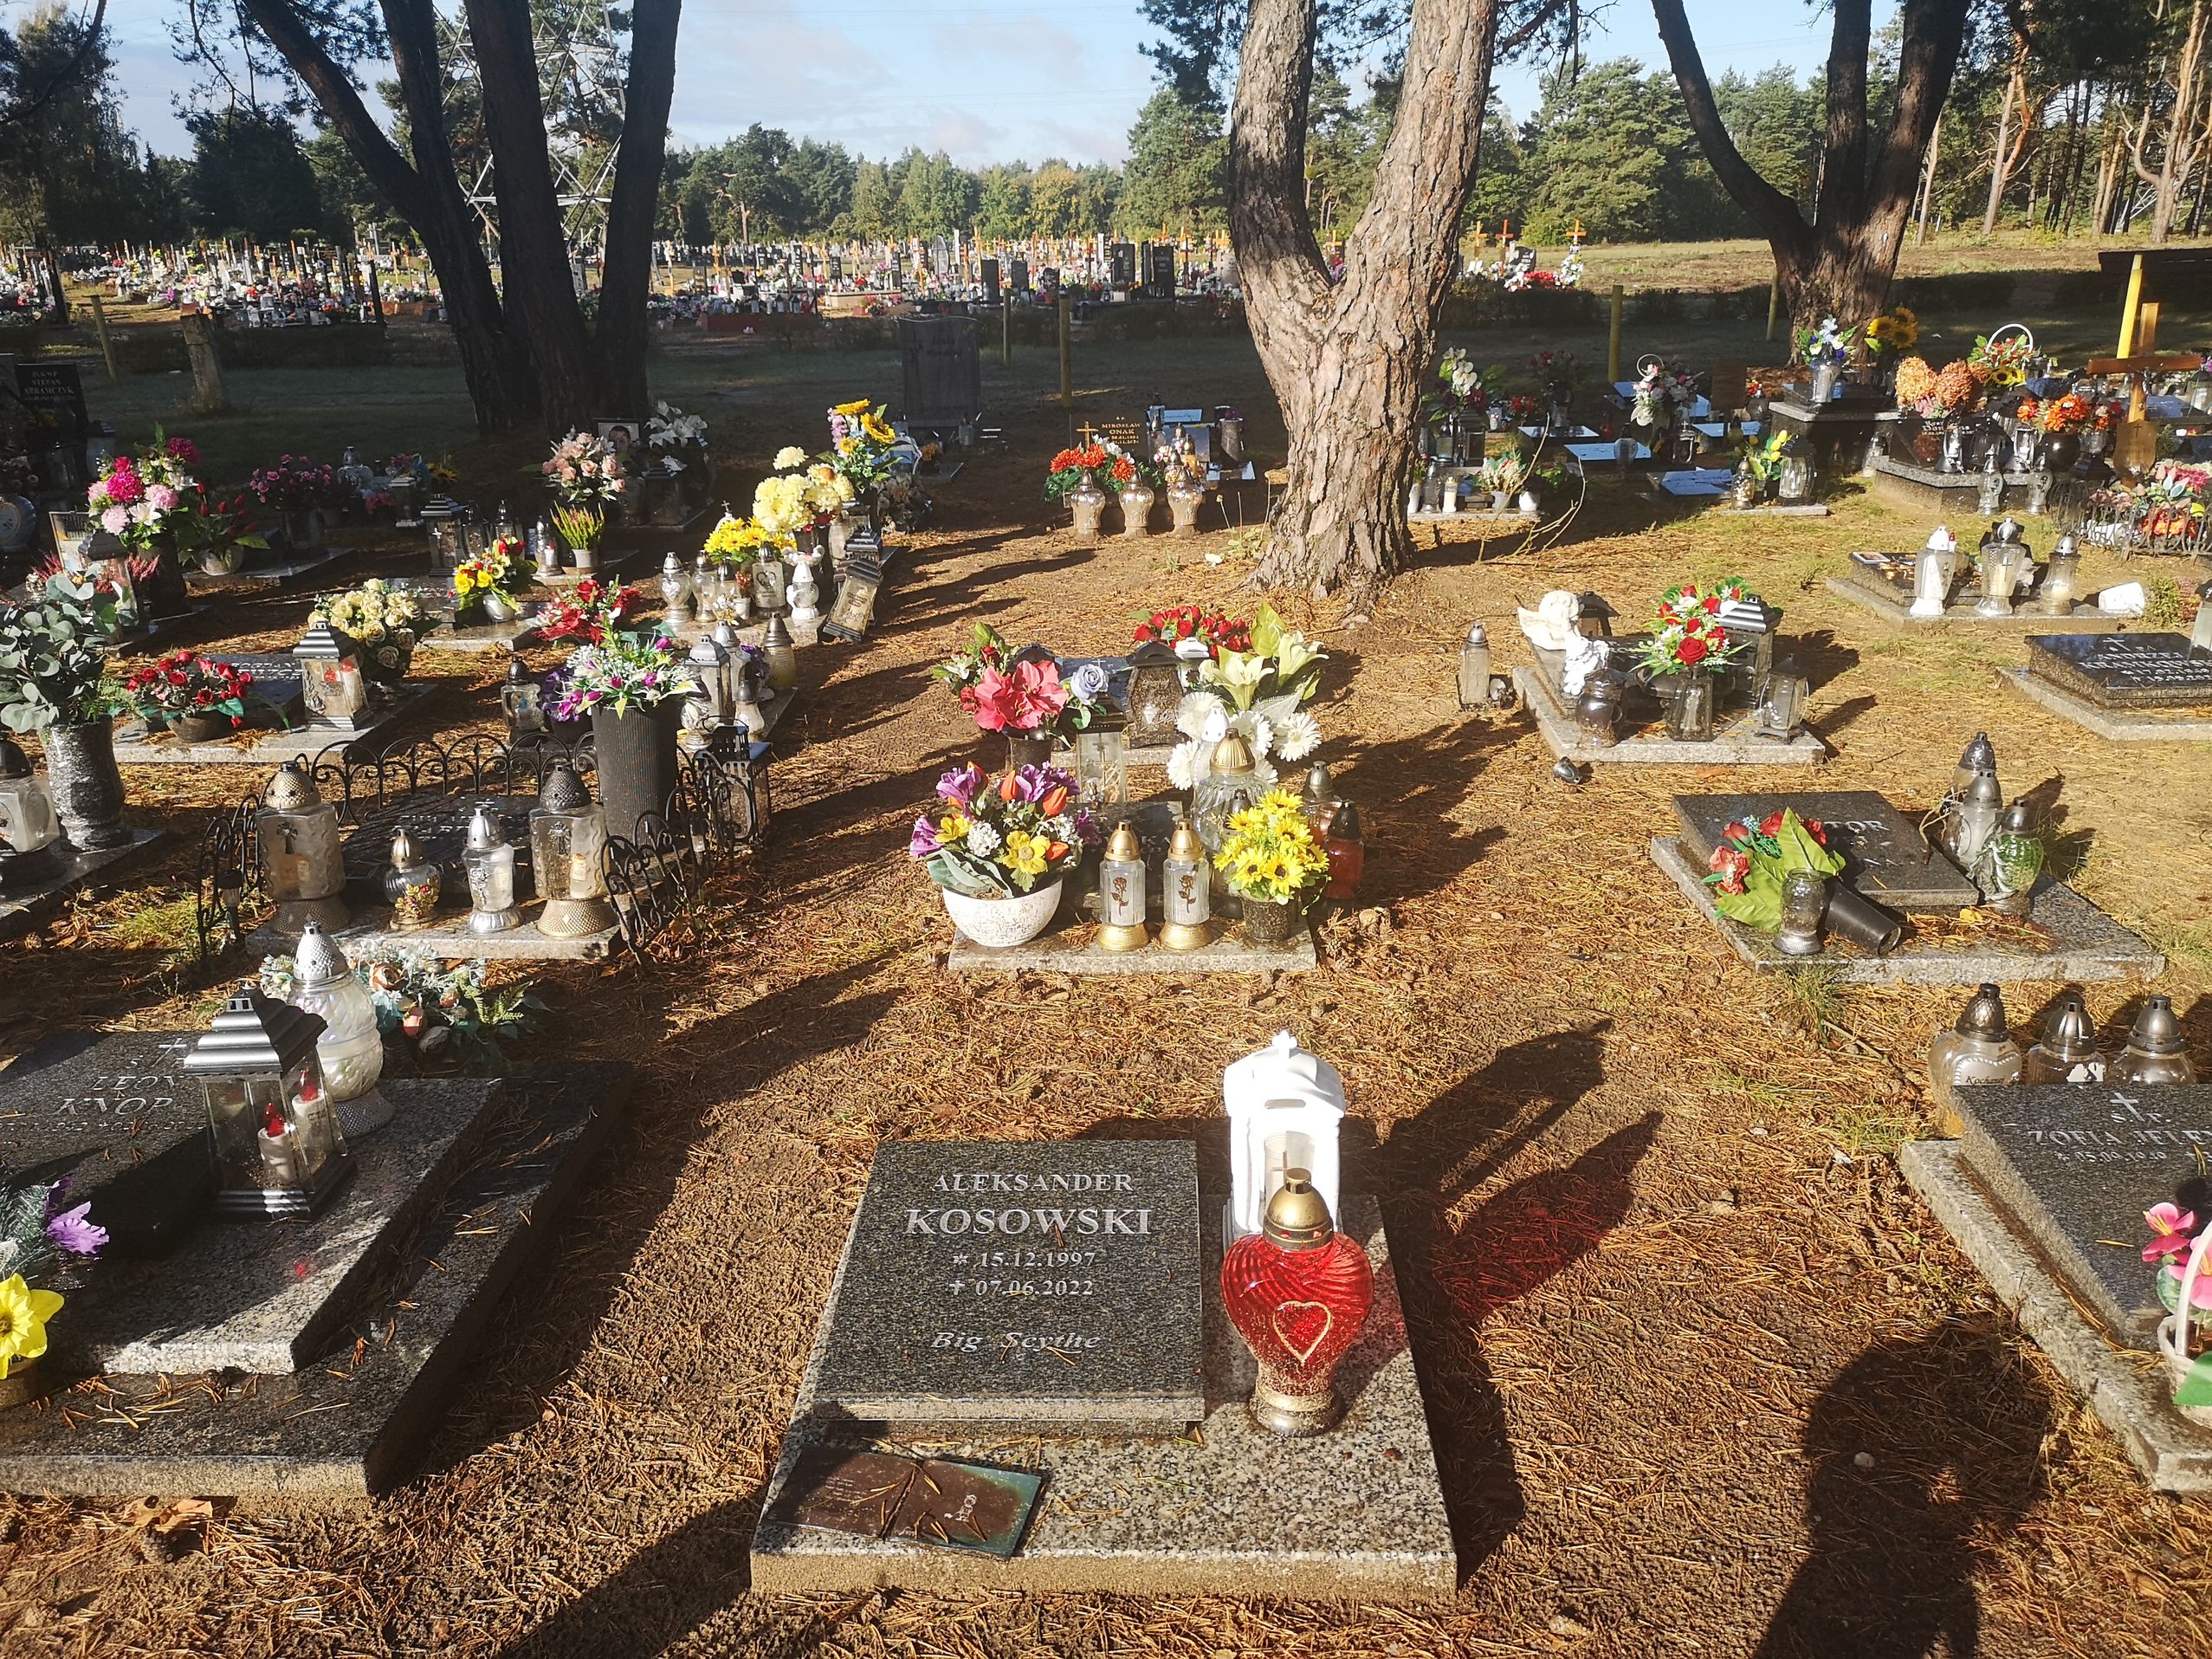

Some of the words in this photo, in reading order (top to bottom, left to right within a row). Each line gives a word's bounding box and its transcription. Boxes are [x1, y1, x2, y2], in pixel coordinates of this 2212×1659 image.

[1823, 820, 1891, 833] TOR
[88, 1075, 185, 1091] LEON
[52, 1097, 174, 1116] KNOP
[2027, 1131, 2127, 1146] ZOFIA
[932, 1173, 1135, 1192] ALEKSANDER
[904, 1208, 1152, 1235] KOSOWSKI
[980, 1252, 1096, 1267] 15.12.1997
[975, 1280, 1094, 1296] 07.06.2022
[933, 1332, 984, 1352] Big
[999, 1332, 1101, 1352] Scythe
